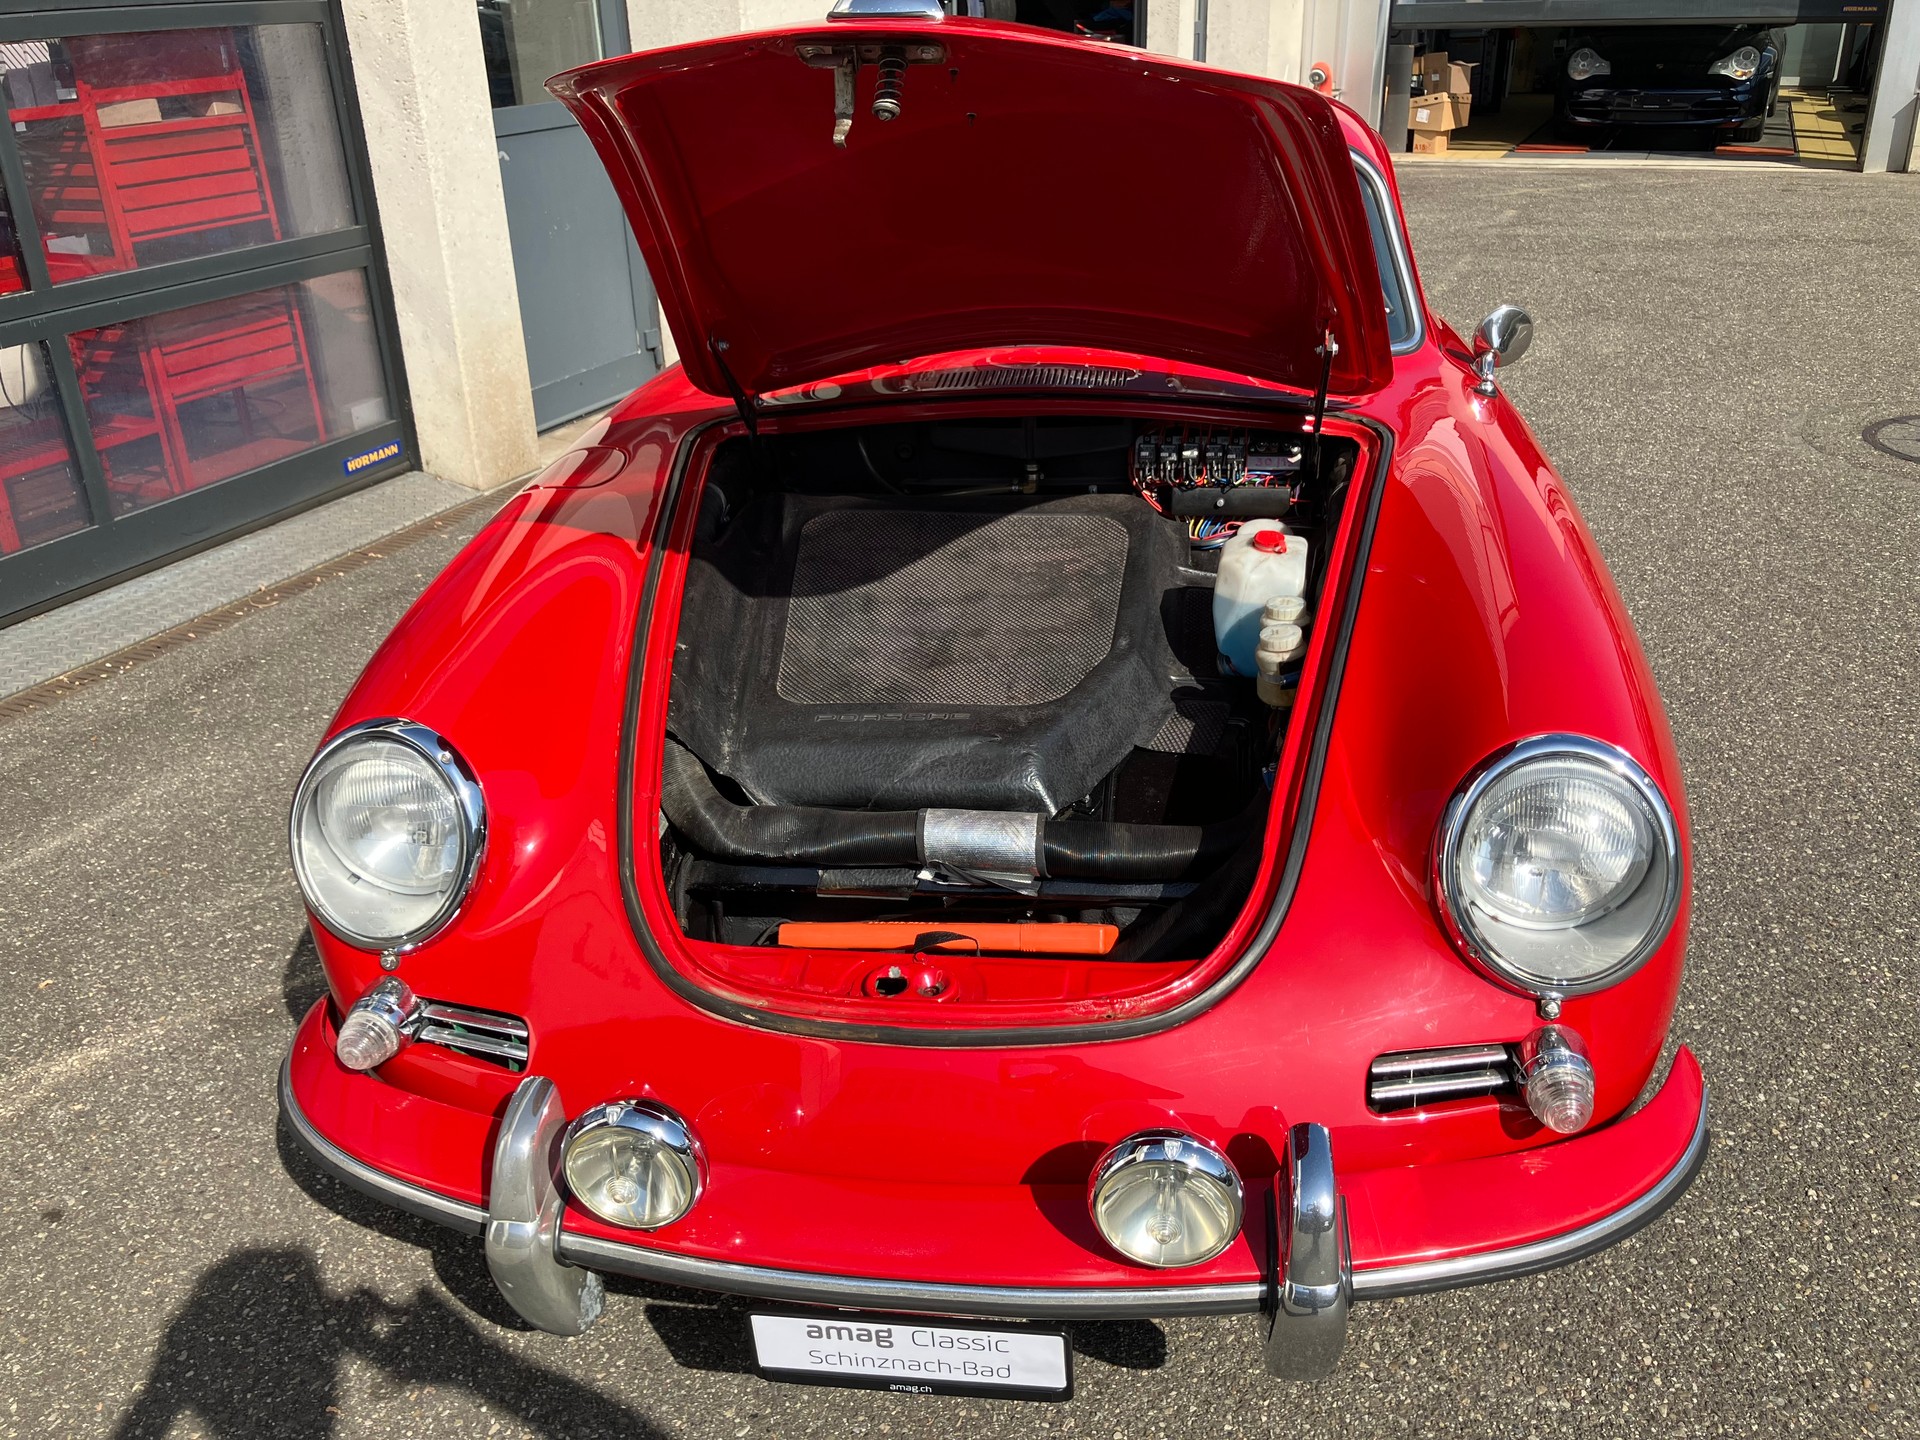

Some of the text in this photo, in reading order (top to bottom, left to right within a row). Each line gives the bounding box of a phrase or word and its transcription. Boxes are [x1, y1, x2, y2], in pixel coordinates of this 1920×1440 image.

[814, 713, 971, 722] PORSCHE
[806, 1324, 1010, 1353] amag Classic
[808, 1349, 1011, 1379] Schinznach-Bad
[889, 1383, 933, 1394] amag.ch
